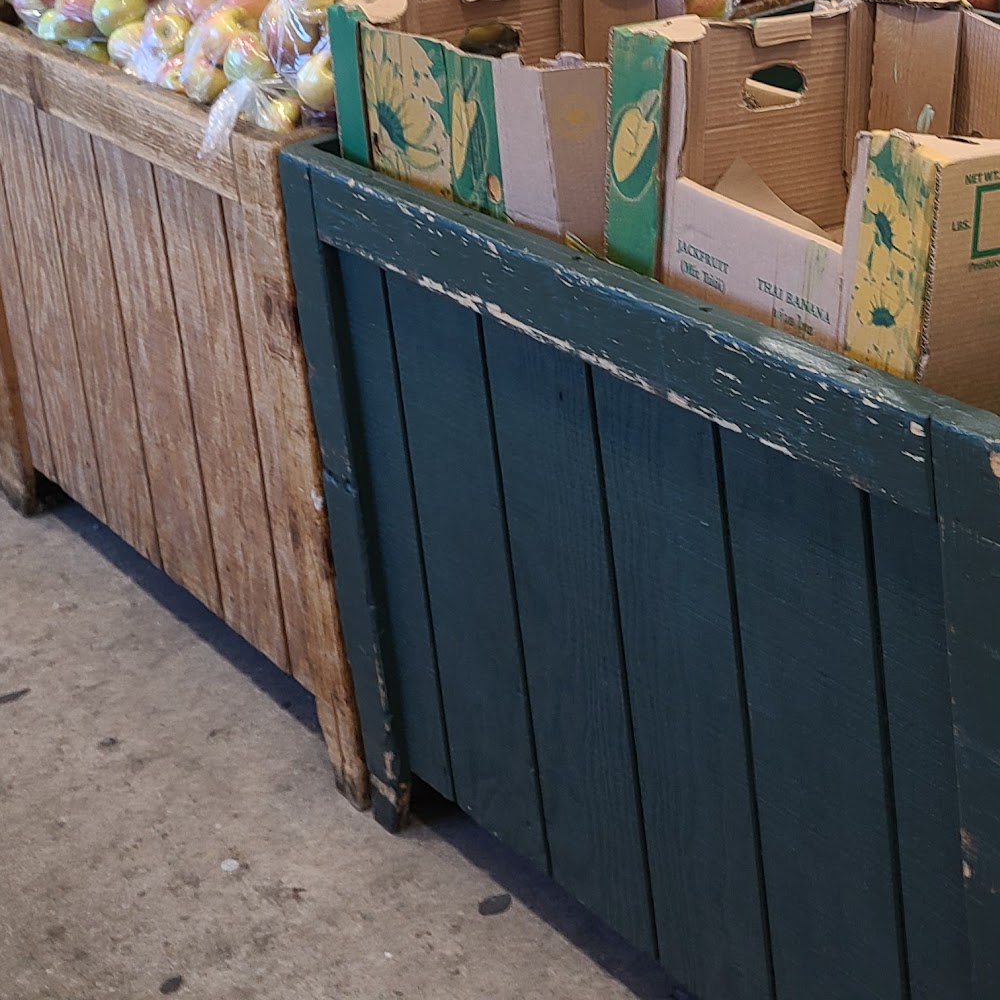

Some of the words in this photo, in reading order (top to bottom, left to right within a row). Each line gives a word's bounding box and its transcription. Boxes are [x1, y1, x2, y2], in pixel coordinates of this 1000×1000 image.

[676, 239, 729, 275] JACKFRUIT
[757, 278, 783, 301] THAI
[786, 295, 831, 326] BANANA
